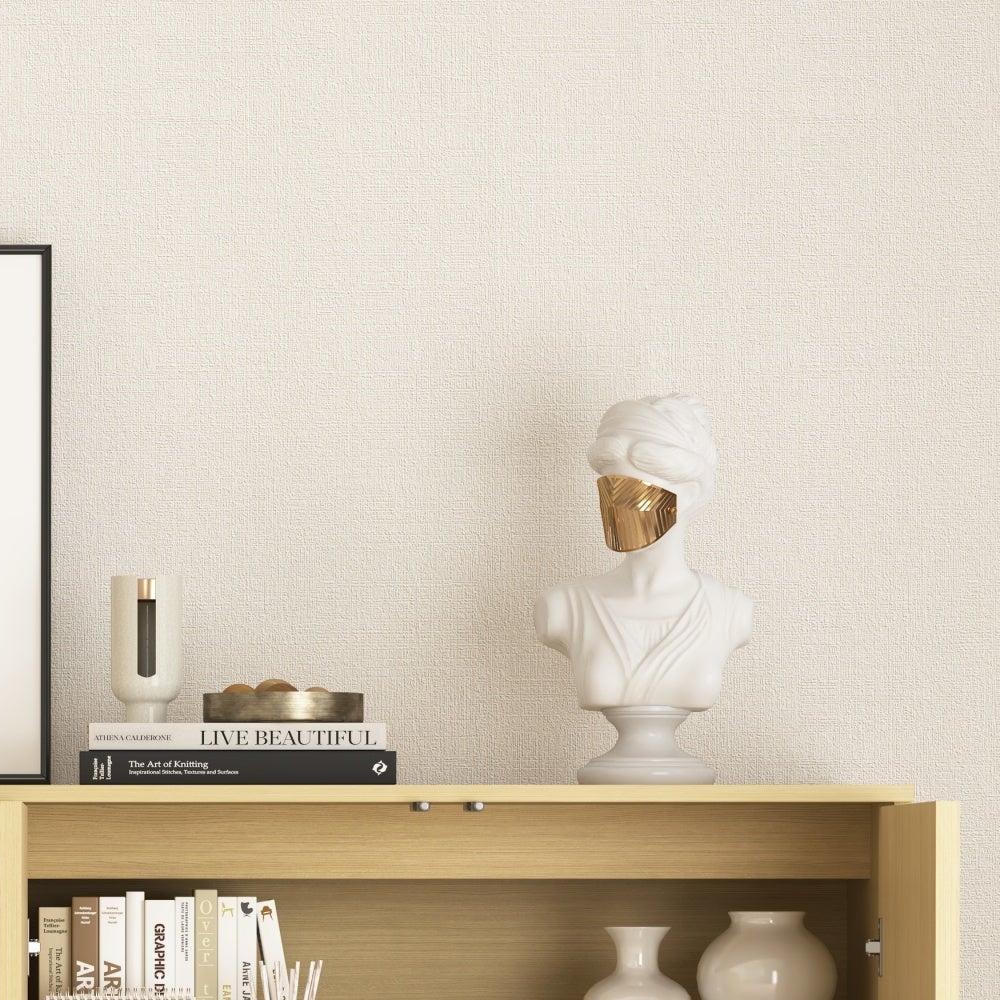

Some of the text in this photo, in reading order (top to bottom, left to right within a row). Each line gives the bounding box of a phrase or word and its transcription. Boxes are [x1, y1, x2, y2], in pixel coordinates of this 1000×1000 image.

[200, 730, 378, 746] LIVE BEAUTIFUL
[128, 760, 208, 769] The Art of Knitting
[200, 900, 213, 963] Over
[154, 923, 165, 979] GRAPHIC
[56, 976, 62, 984] of
